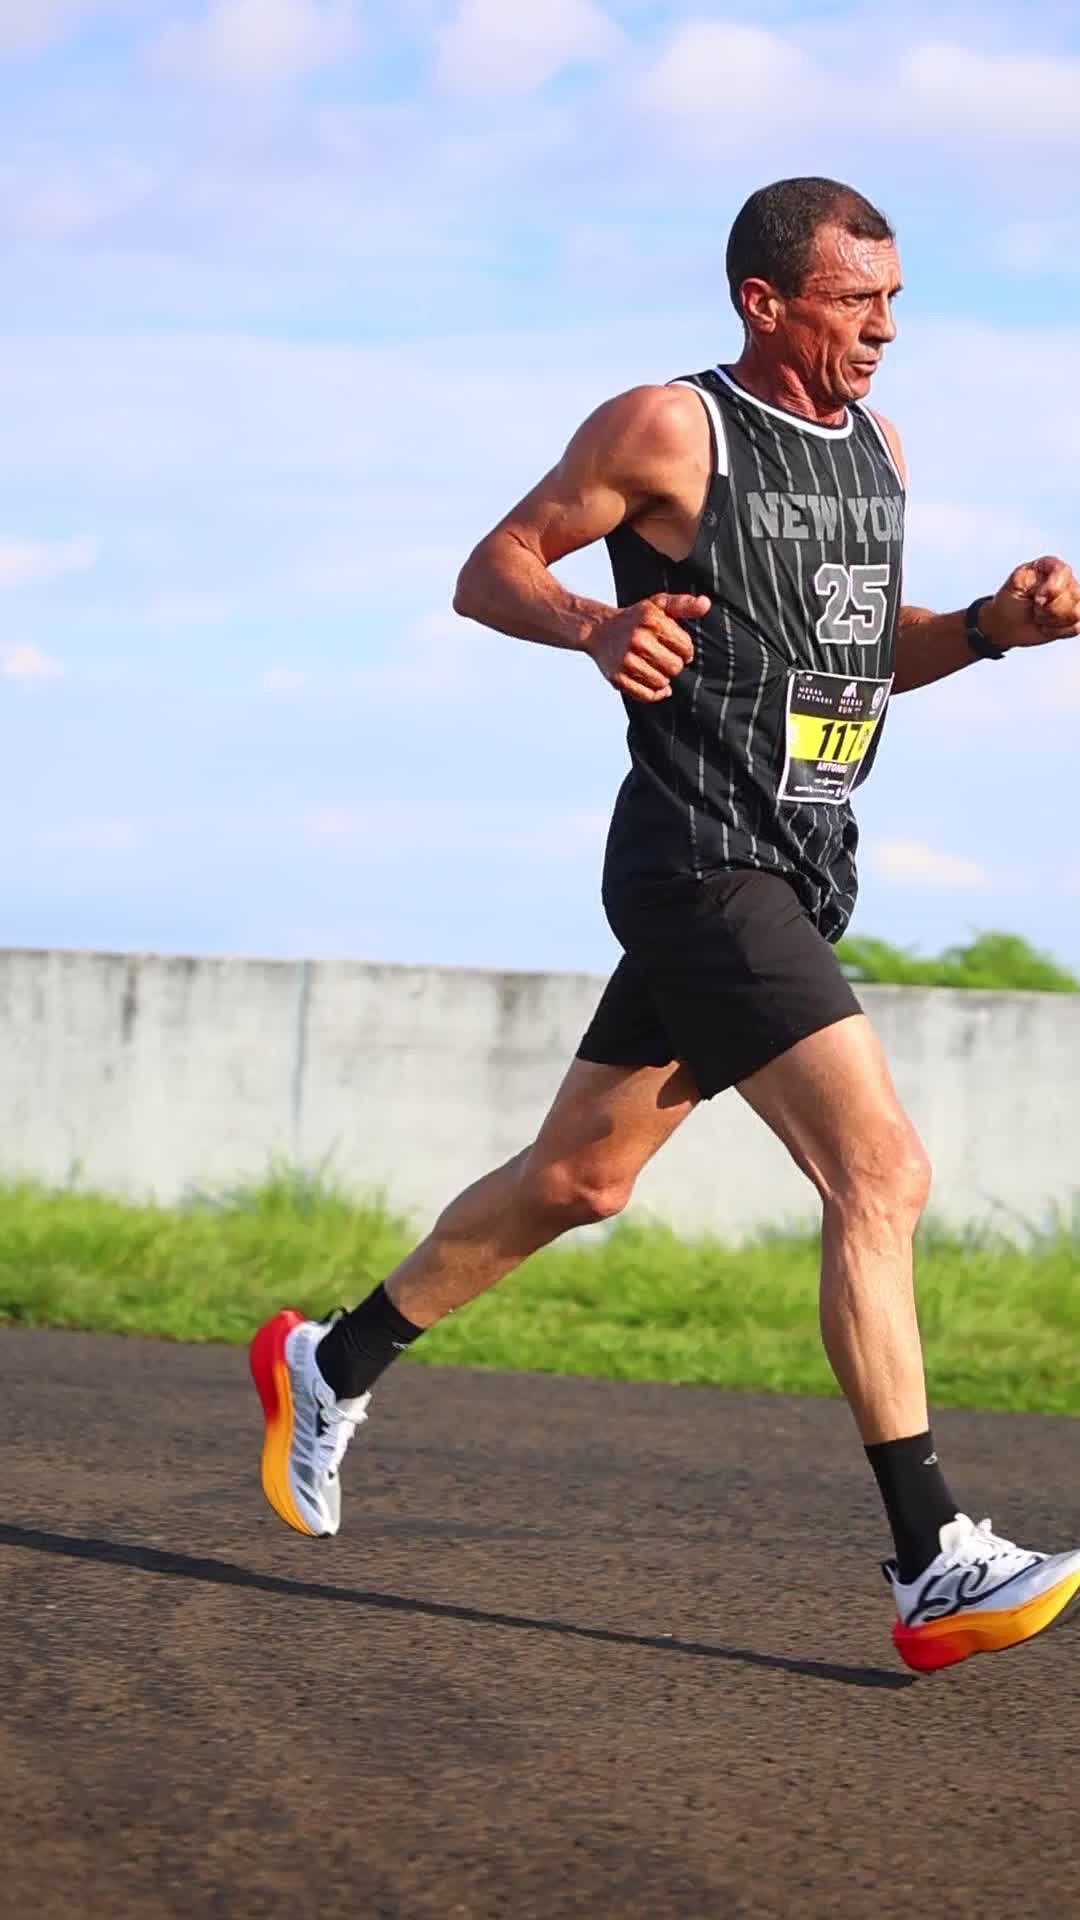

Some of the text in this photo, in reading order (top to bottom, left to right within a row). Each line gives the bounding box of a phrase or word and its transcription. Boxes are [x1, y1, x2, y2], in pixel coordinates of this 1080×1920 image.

[747, 491, 838, 541] NEW
[814, 563, 890, 645] 25
[797, 693, 833, 705] PARTNERS
[838, 705, 853, 715] RUN
